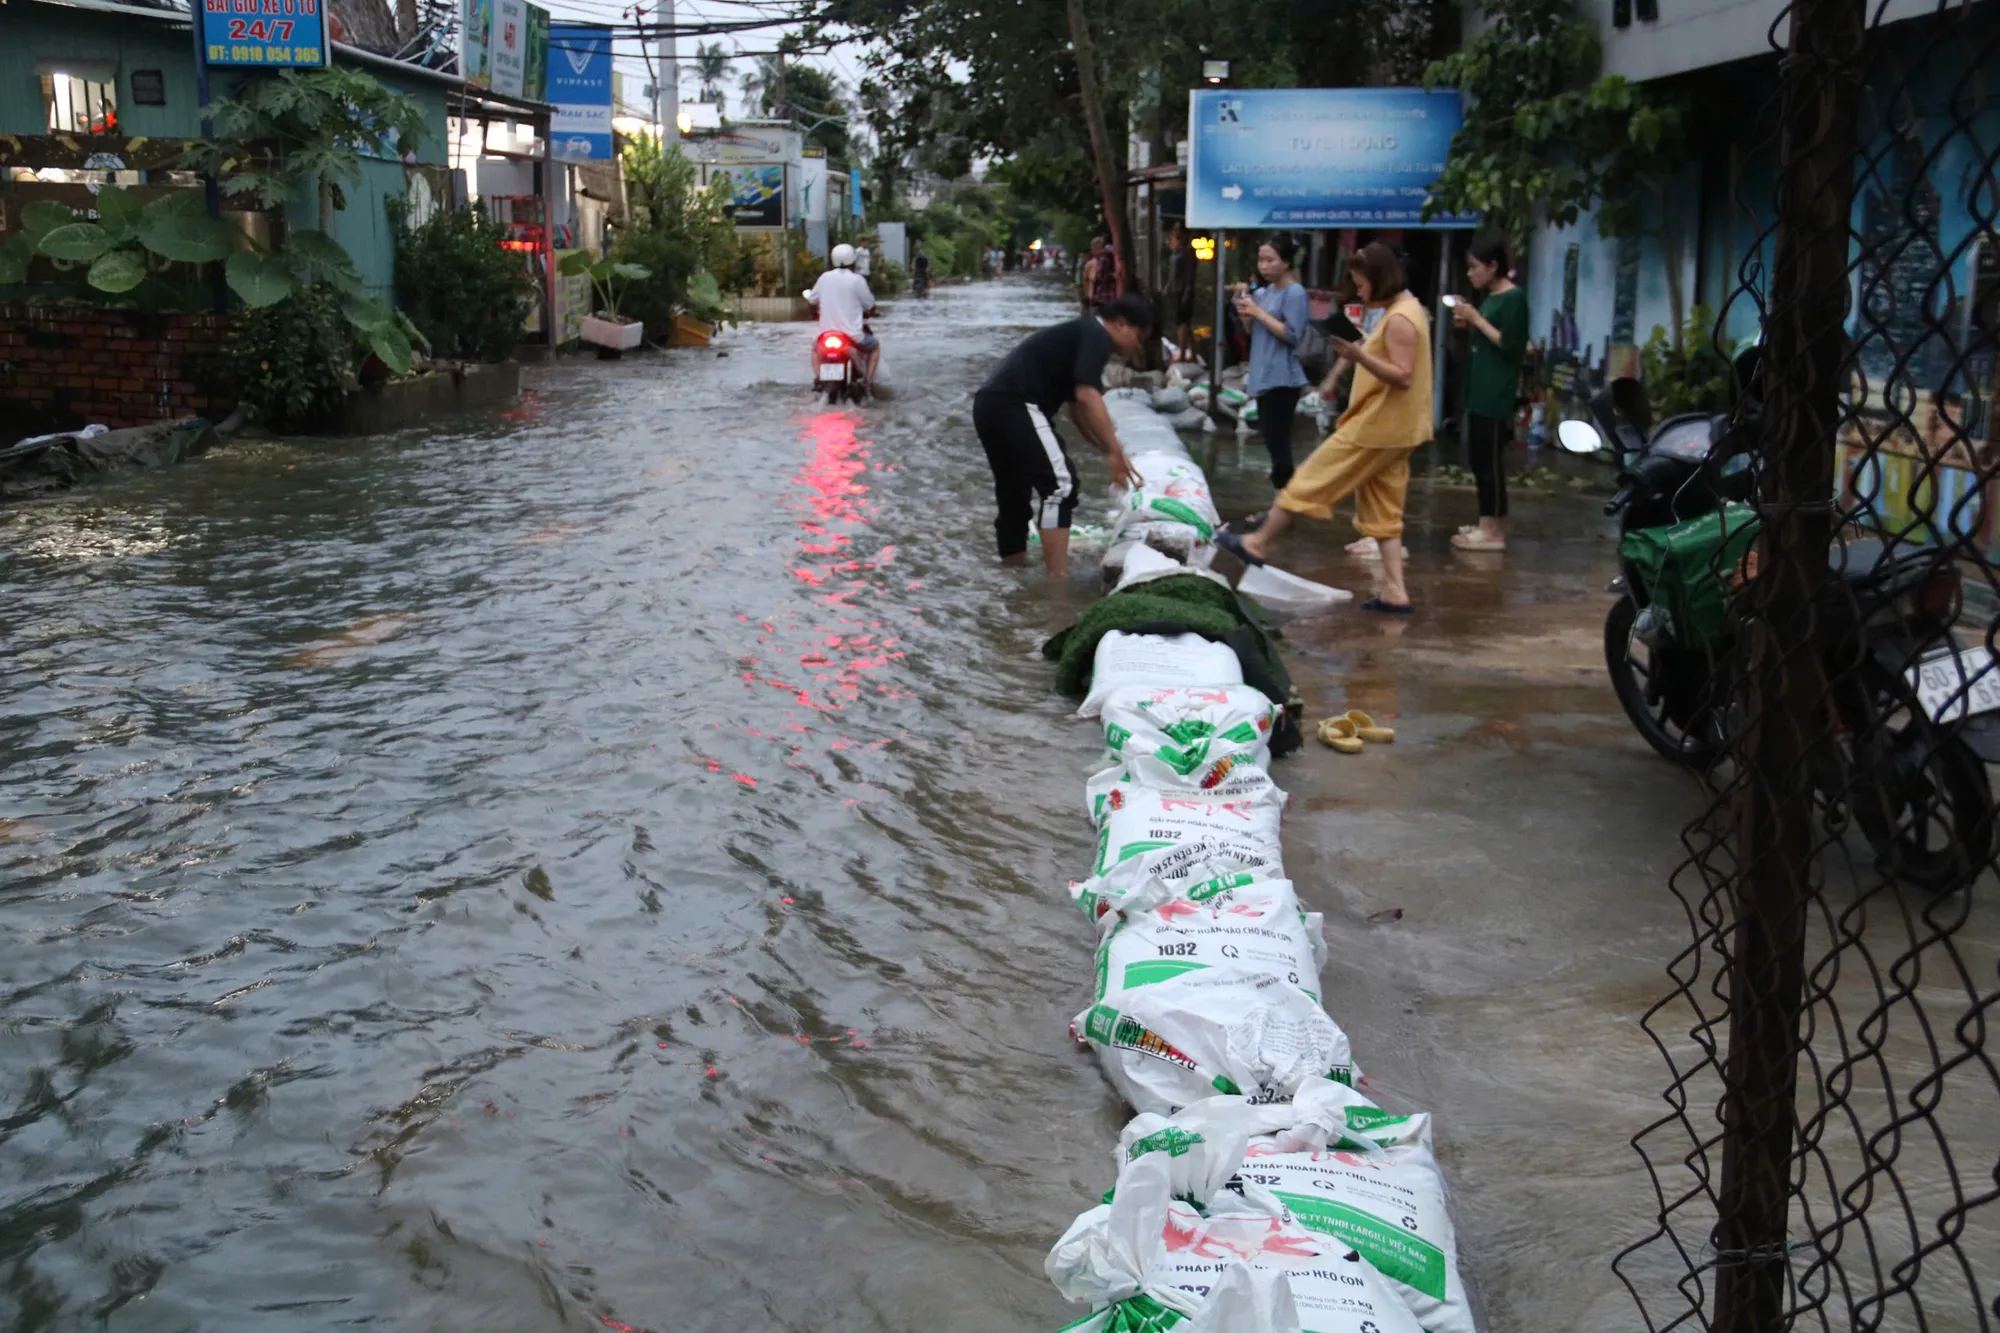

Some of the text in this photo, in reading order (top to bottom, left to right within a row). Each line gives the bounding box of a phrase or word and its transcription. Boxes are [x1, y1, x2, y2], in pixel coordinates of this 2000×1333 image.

[229, 19, 295, 42] 24/7
[1148, 828, 1183, 840] 1032
[1157, 942, 1199, 956] 1032
[1345, 1170, 1367, 1183] CHO
[1369, 1178, 1391, 1189] HEO
[1392, 1184, 1415, 1197] CON
[1322, 1215, 1350, 1231] TNHH
[1350, 1222, 1387, 1244] CARGILL
[1407, 1246, 1428, 1264] NAM
[1312, 1269, 1339, 1282] HEO
[1340, 1275, 1365, 1287] CON
[1340, 1297, 1356, 1306] 25
[1357, 1300, 1374, 1311] kg
